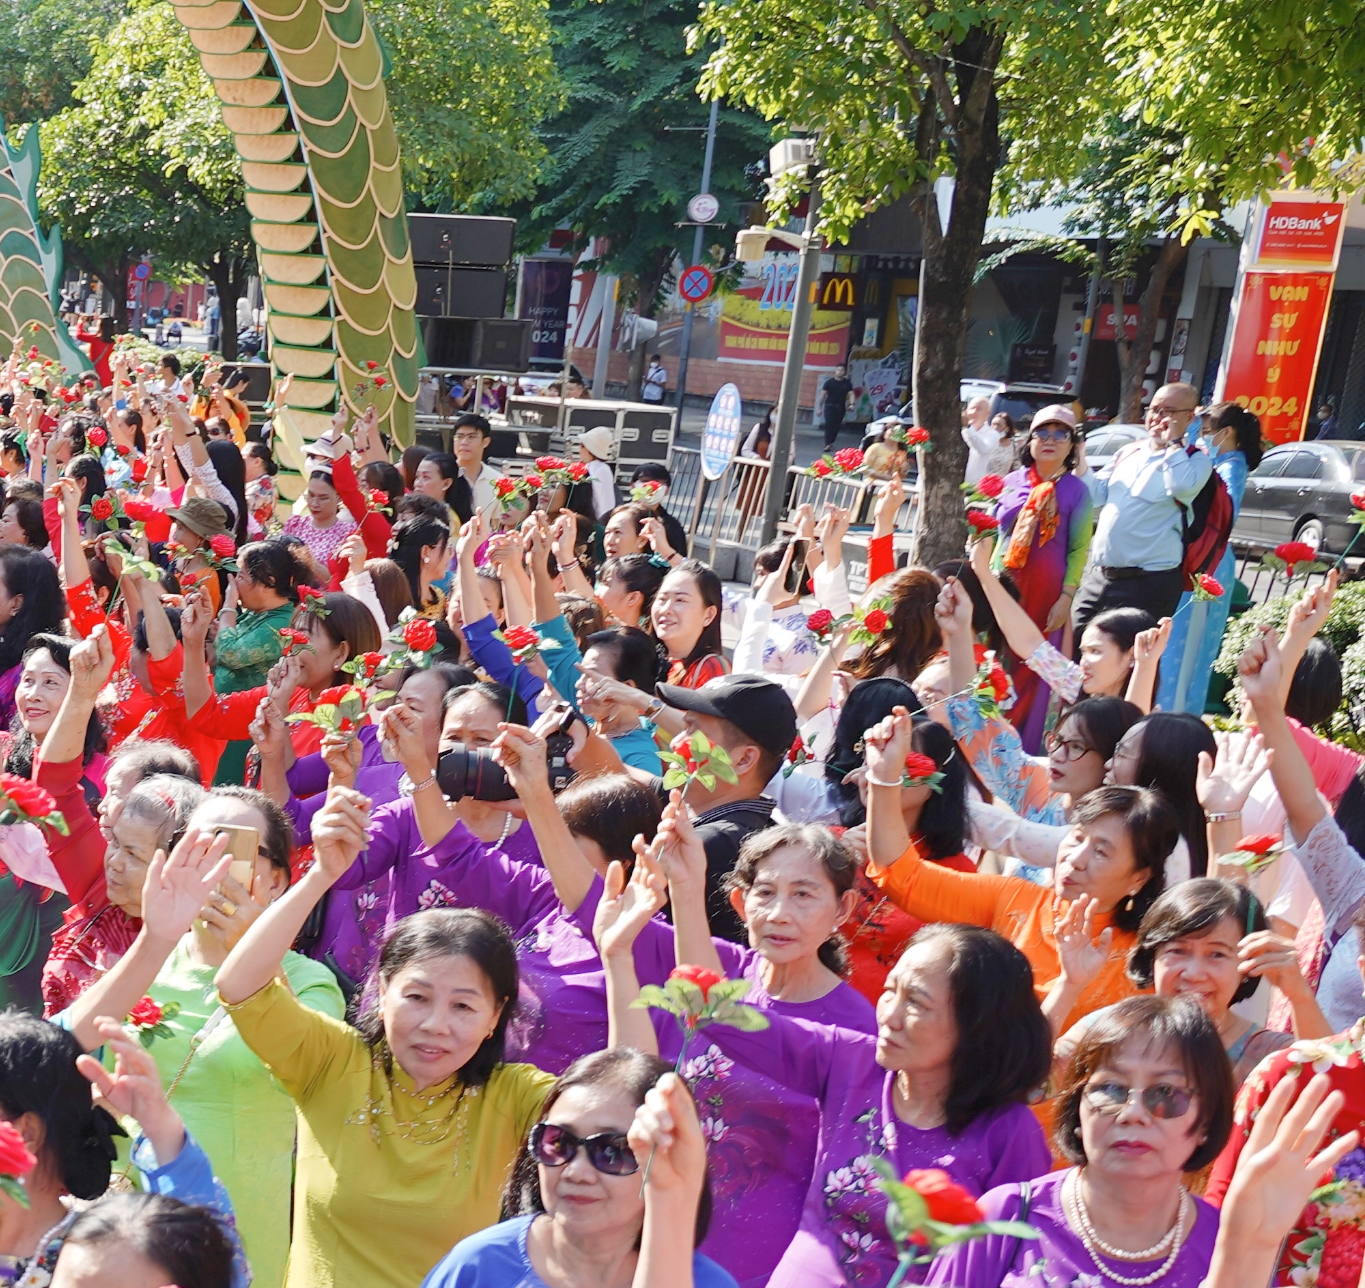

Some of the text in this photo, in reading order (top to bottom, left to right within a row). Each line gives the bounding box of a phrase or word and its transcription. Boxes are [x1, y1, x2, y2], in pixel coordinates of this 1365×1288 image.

[1268, 215, 1323, 231] HDBank
[760, 263, 799, 311] 202
[1269, 285, 1308, 306] VẠN
[528, 306, 560, 315] HAPPY
[542, 319, 565, 329] YEAR
[1270, 312, 1299, 333] SỰ
[532, 331, 558, 343] 024
[1256, 338, 1300, 356] NHƯ
[1235, 395, 1298, 417] 2024
